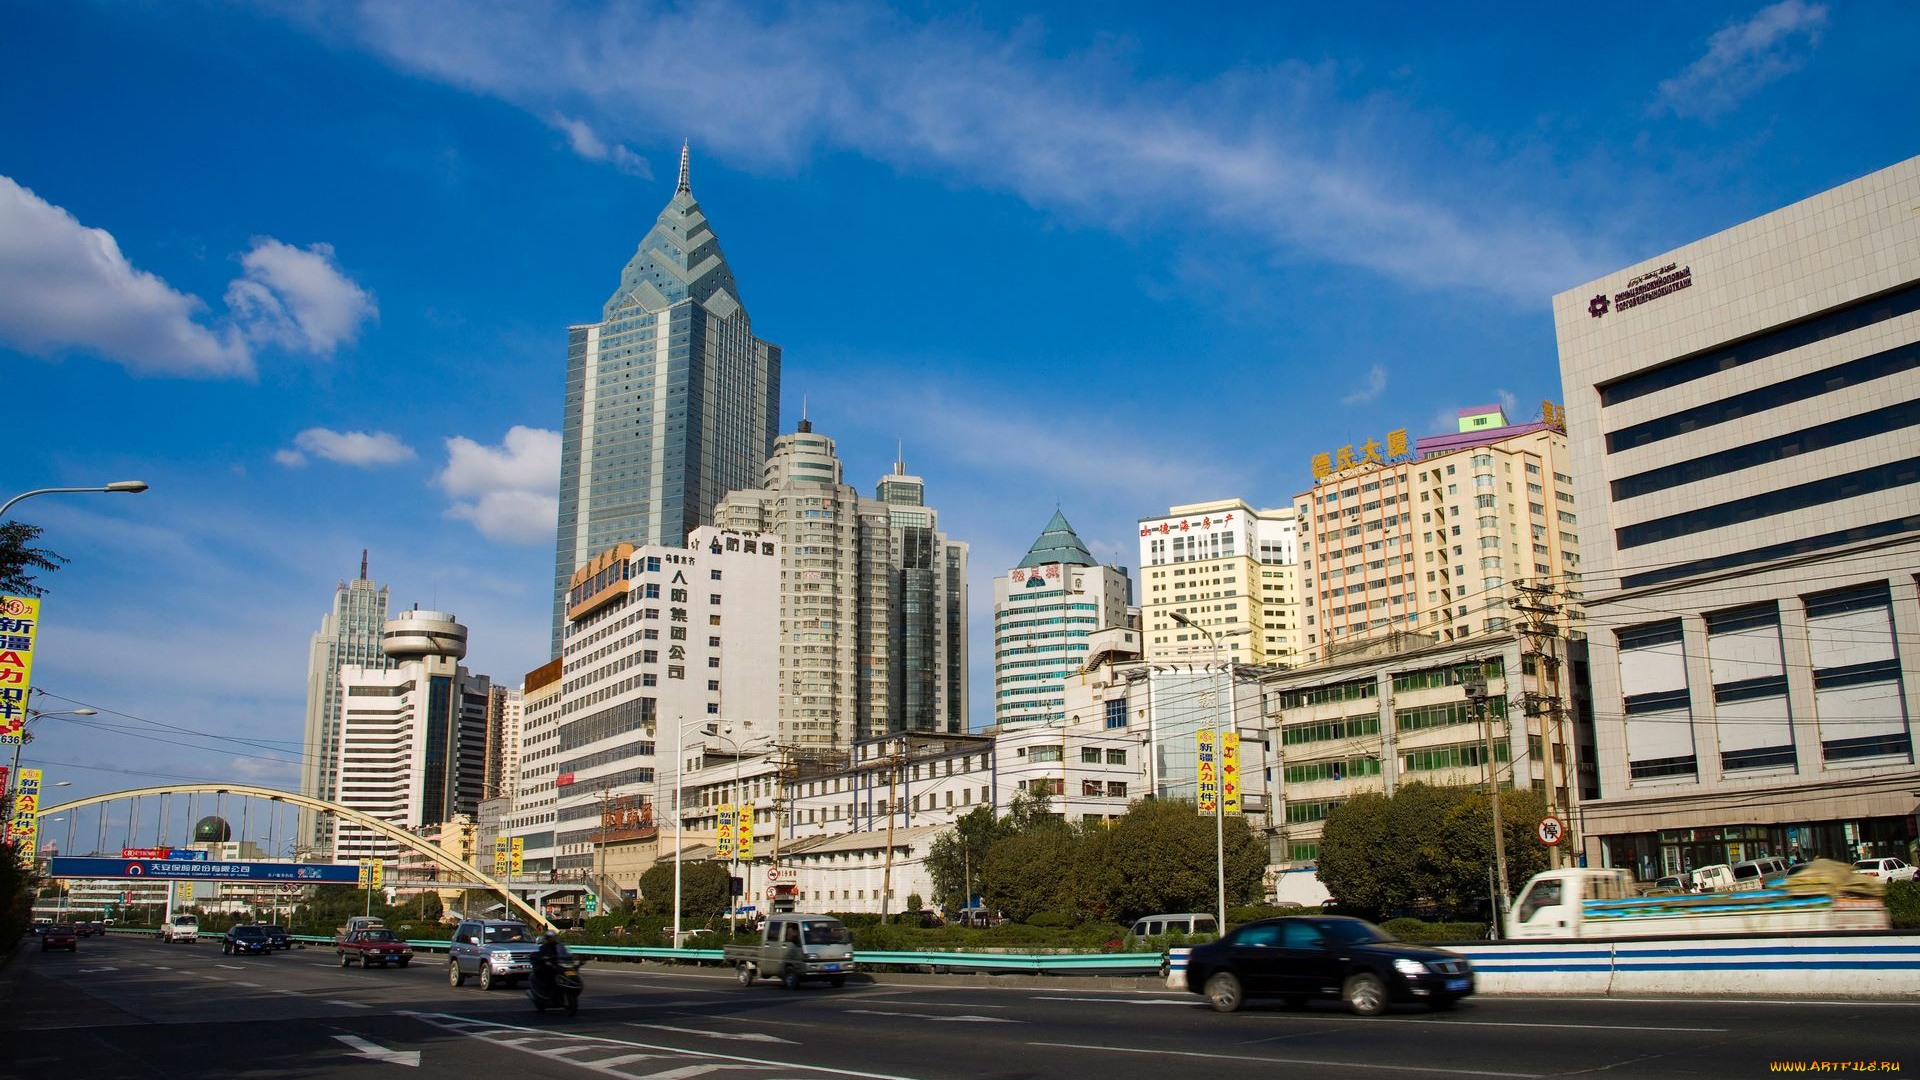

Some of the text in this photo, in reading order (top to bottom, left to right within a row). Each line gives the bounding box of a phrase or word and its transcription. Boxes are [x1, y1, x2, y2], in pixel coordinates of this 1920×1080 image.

[1311, 428, 1408, 479] 德氏大厦
[665, 554, 695, 566] 乌鲁木齐
[668, 569, 688, 680] 人防集团公司
[1199, 742, 1214, 802] 新疆A力扣件
[1543, 822, 1557, 839] 停
[151, 863, 250, 873] 天安保险股份有限公司
